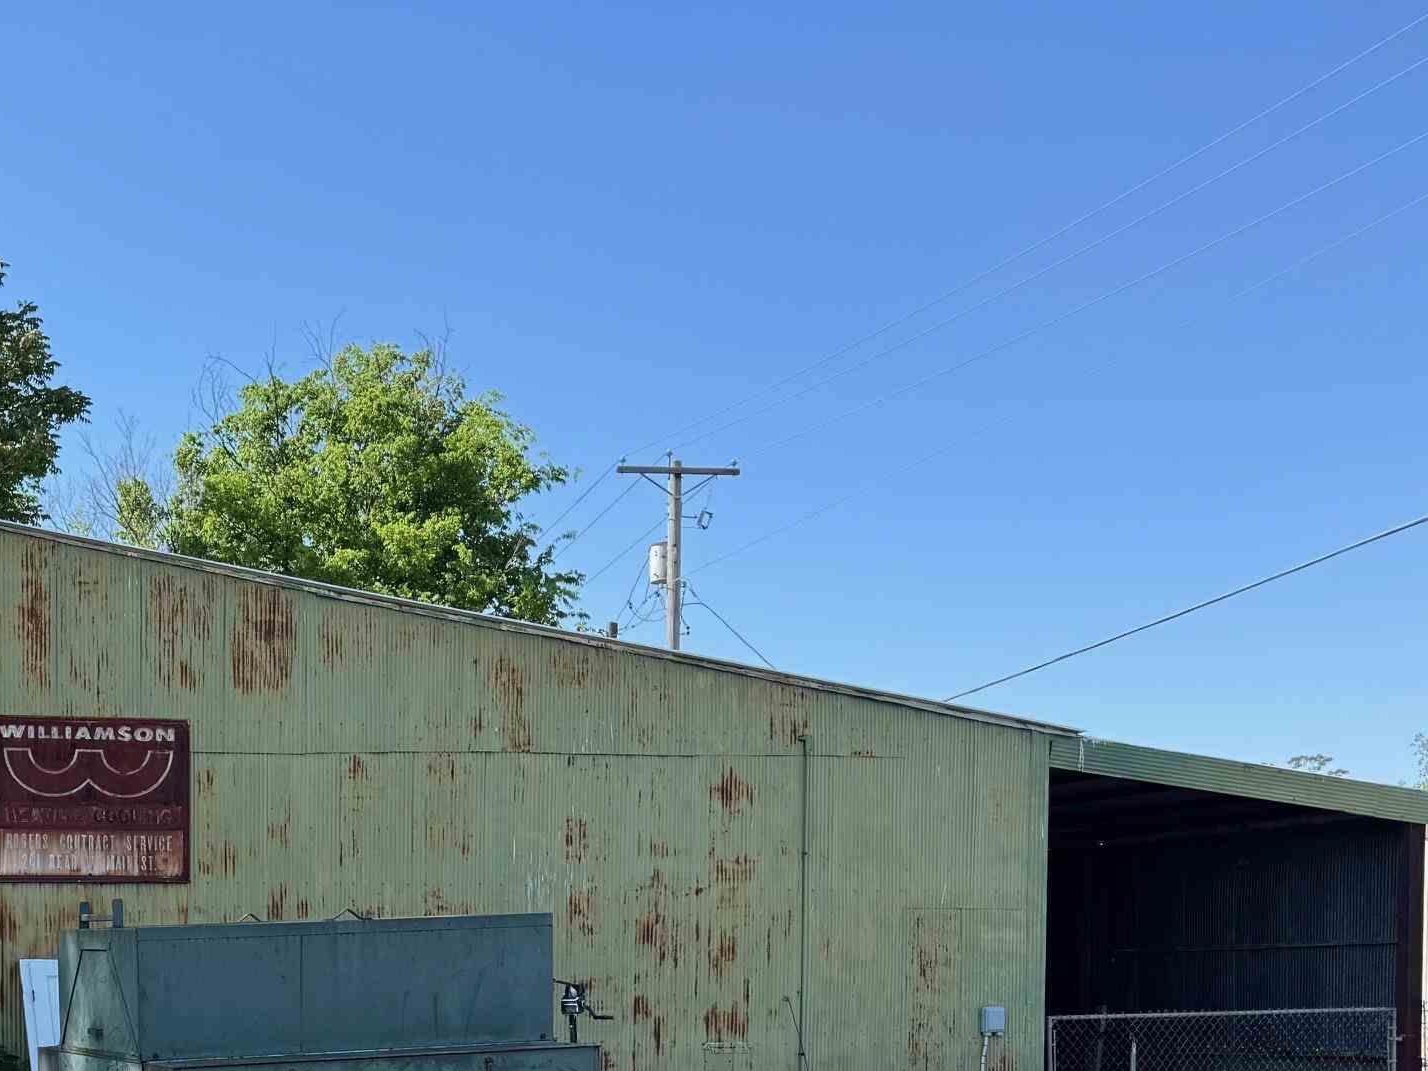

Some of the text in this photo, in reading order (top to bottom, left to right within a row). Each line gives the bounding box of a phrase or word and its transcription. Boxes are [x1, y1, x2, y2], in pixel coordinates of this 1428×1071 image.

[0, 725, 175, 742] WILLIAMSON
[6, 832, 173, 852] ROGERS CONTRACT SERVICE
